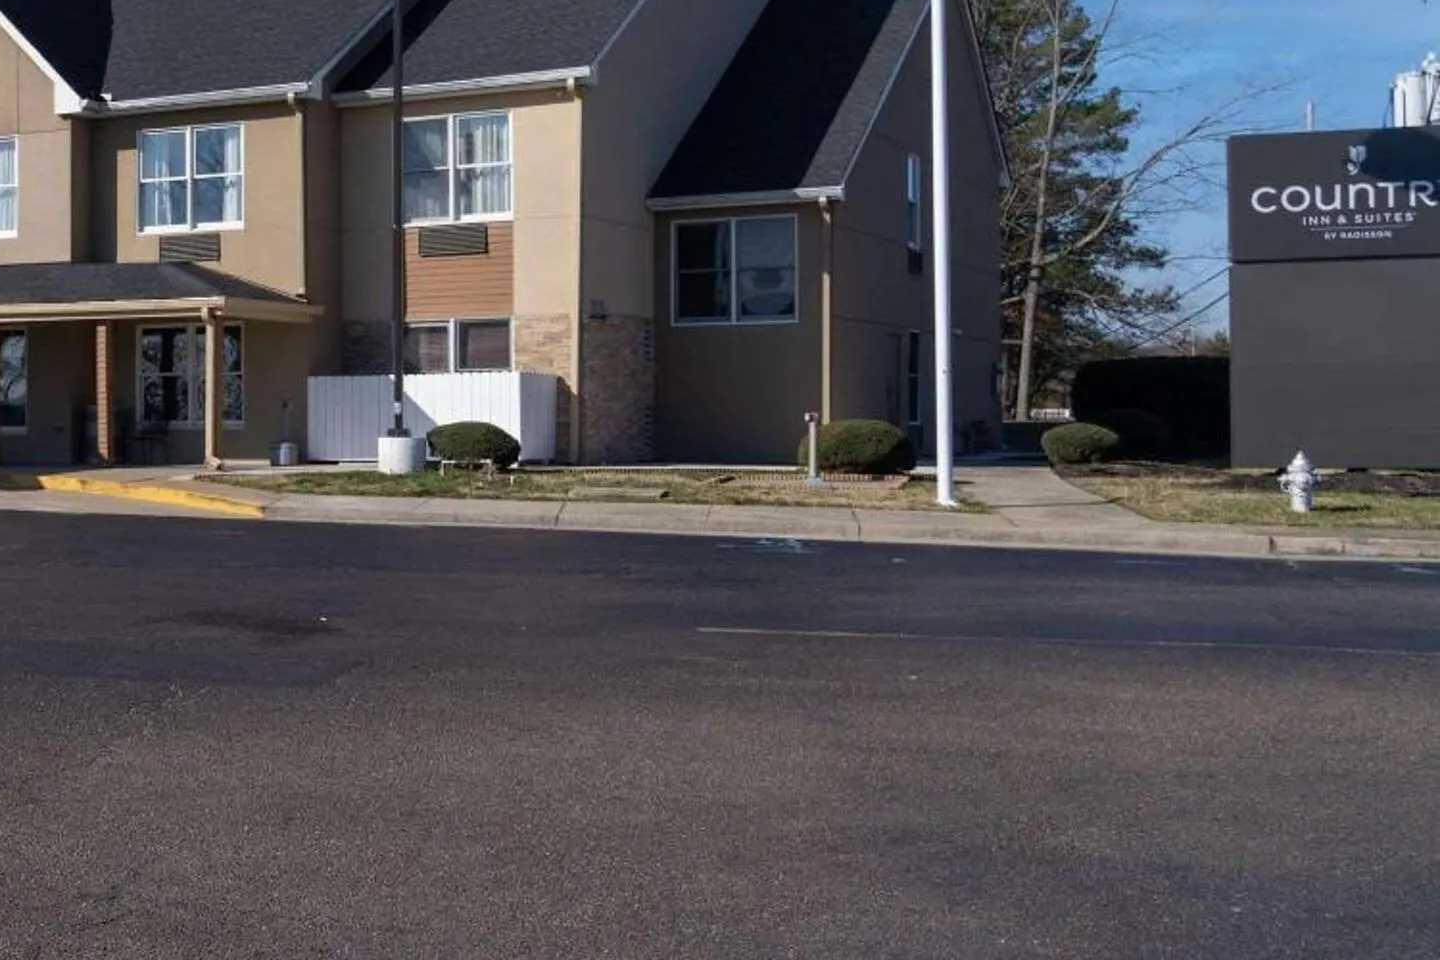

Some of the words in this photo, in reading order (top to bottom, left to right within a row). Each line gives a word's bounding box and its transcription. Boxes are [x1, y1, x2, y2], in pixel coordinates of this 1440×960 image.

[1250, 180, 1440, 214] COUNTR
[1302, 215, 1331, 226] INN
[1337, 214, 1348, 225] &
[1324, 231, 1337, 240] BY
[1340, 230, 1393, 240] RADISSON
